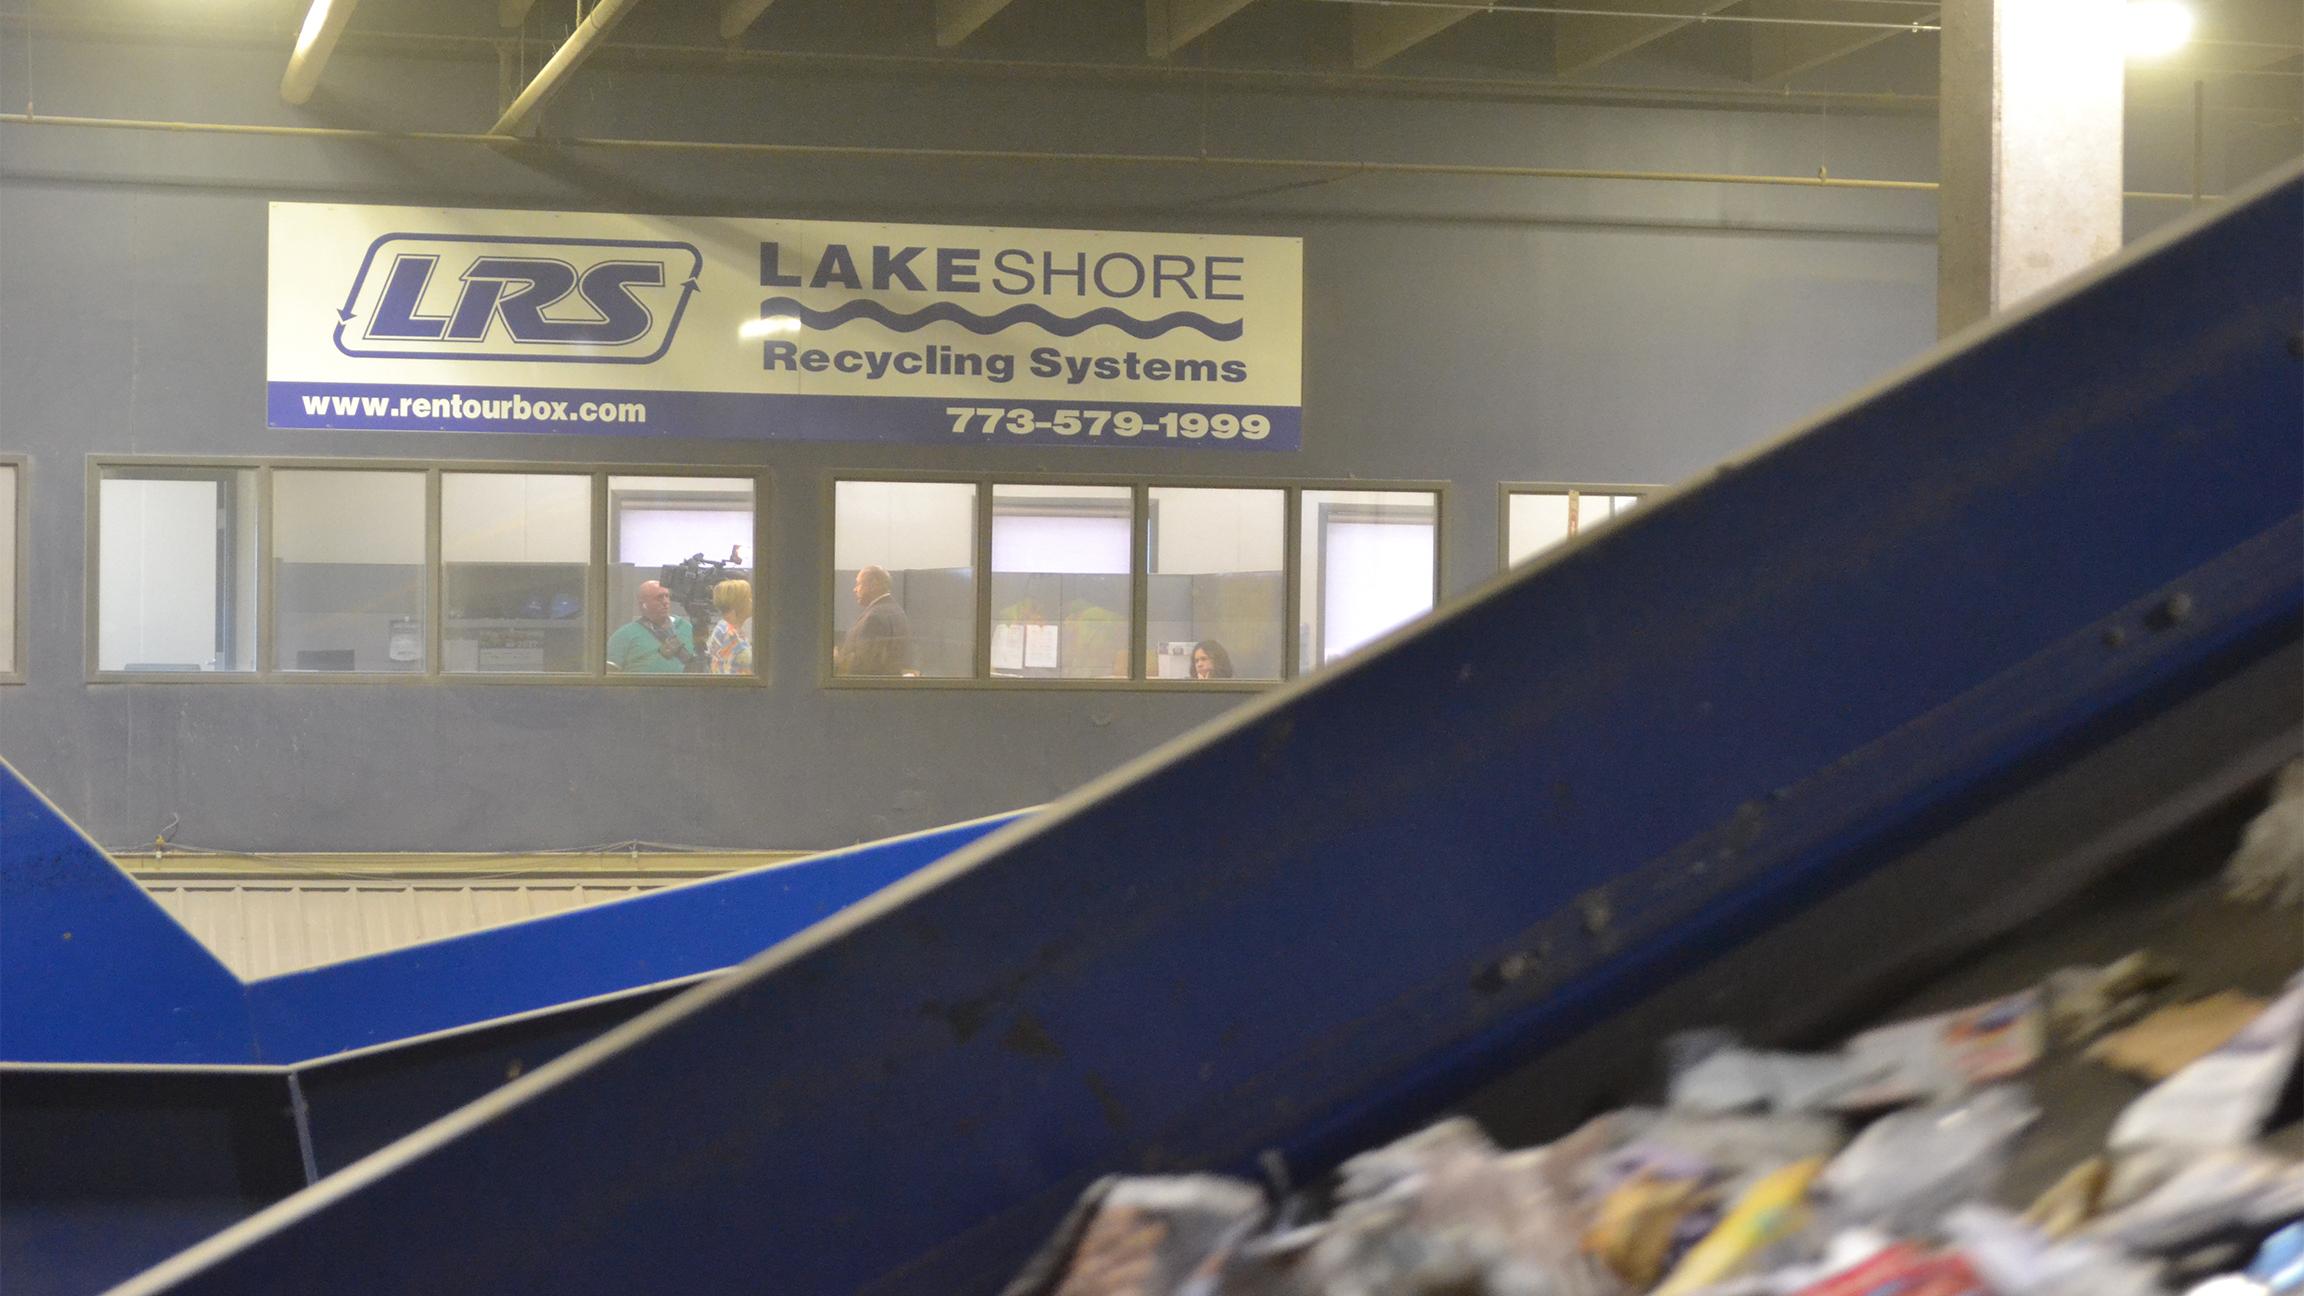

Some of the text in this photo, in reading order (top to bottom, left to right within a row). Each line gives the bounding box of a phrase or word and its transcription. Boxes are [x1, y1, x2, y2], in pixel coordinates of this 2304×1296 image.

[761, 242, 1244, 301] LAKESHORE
[362, 254, 665, 345] LRS
[762, 341, 1247, 384] Recycling Systems
[303, 394, 646, 423] www.rentourbox.com
[947, 408, 1271, 440] 773-579-1999
